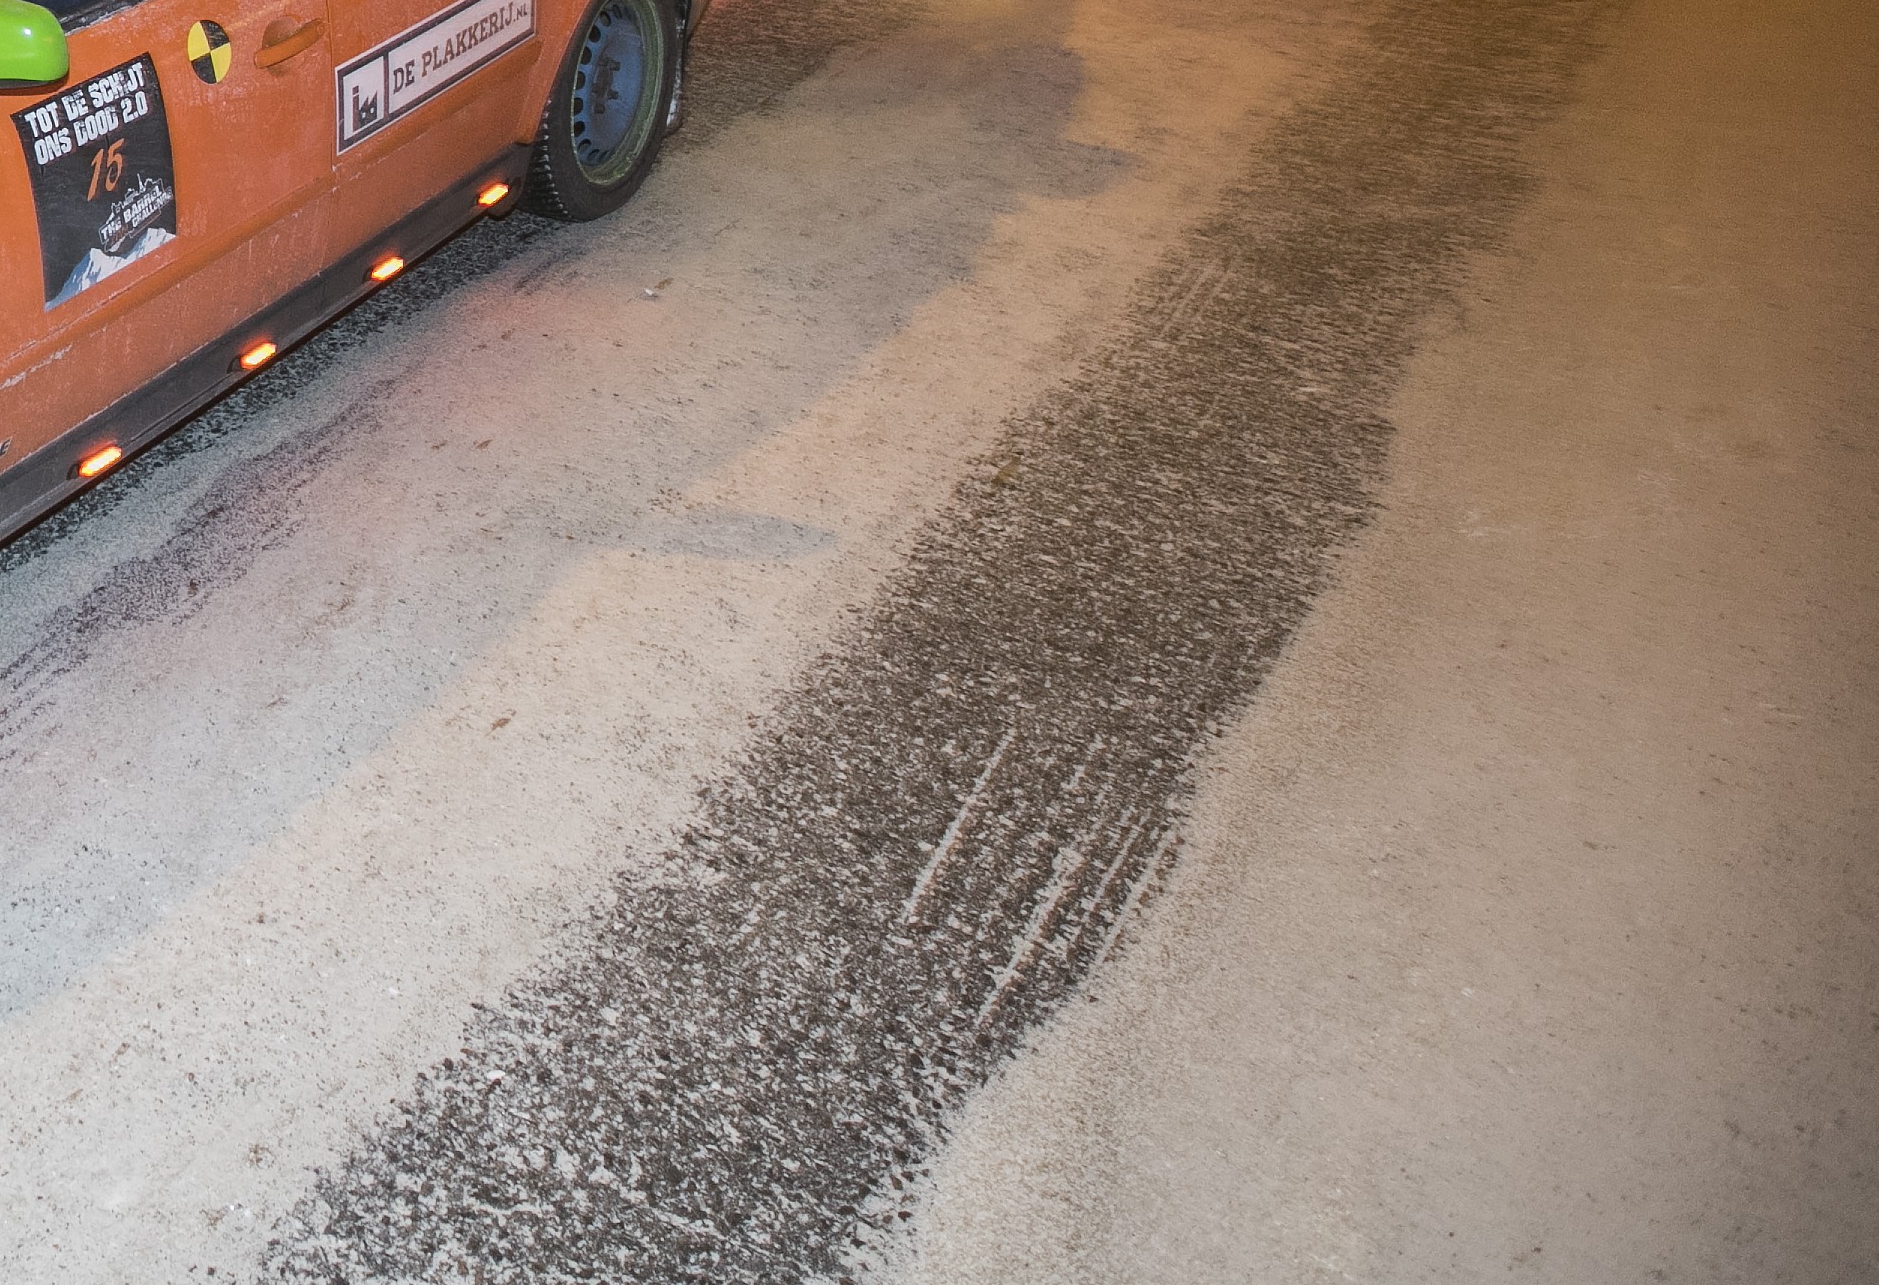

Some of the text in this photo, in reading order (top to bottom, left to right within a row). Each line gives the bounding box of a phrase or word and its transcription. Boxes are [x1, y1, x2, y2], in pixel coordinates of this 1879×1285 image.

[393, 59, 415, 95] DE
[24, 101, 59, 138] TOT
[61, 89, 89, 122] DE
[34, 90, 149, 166] ONS DOOD 2.0
[86, 138, 125, 202] 15
